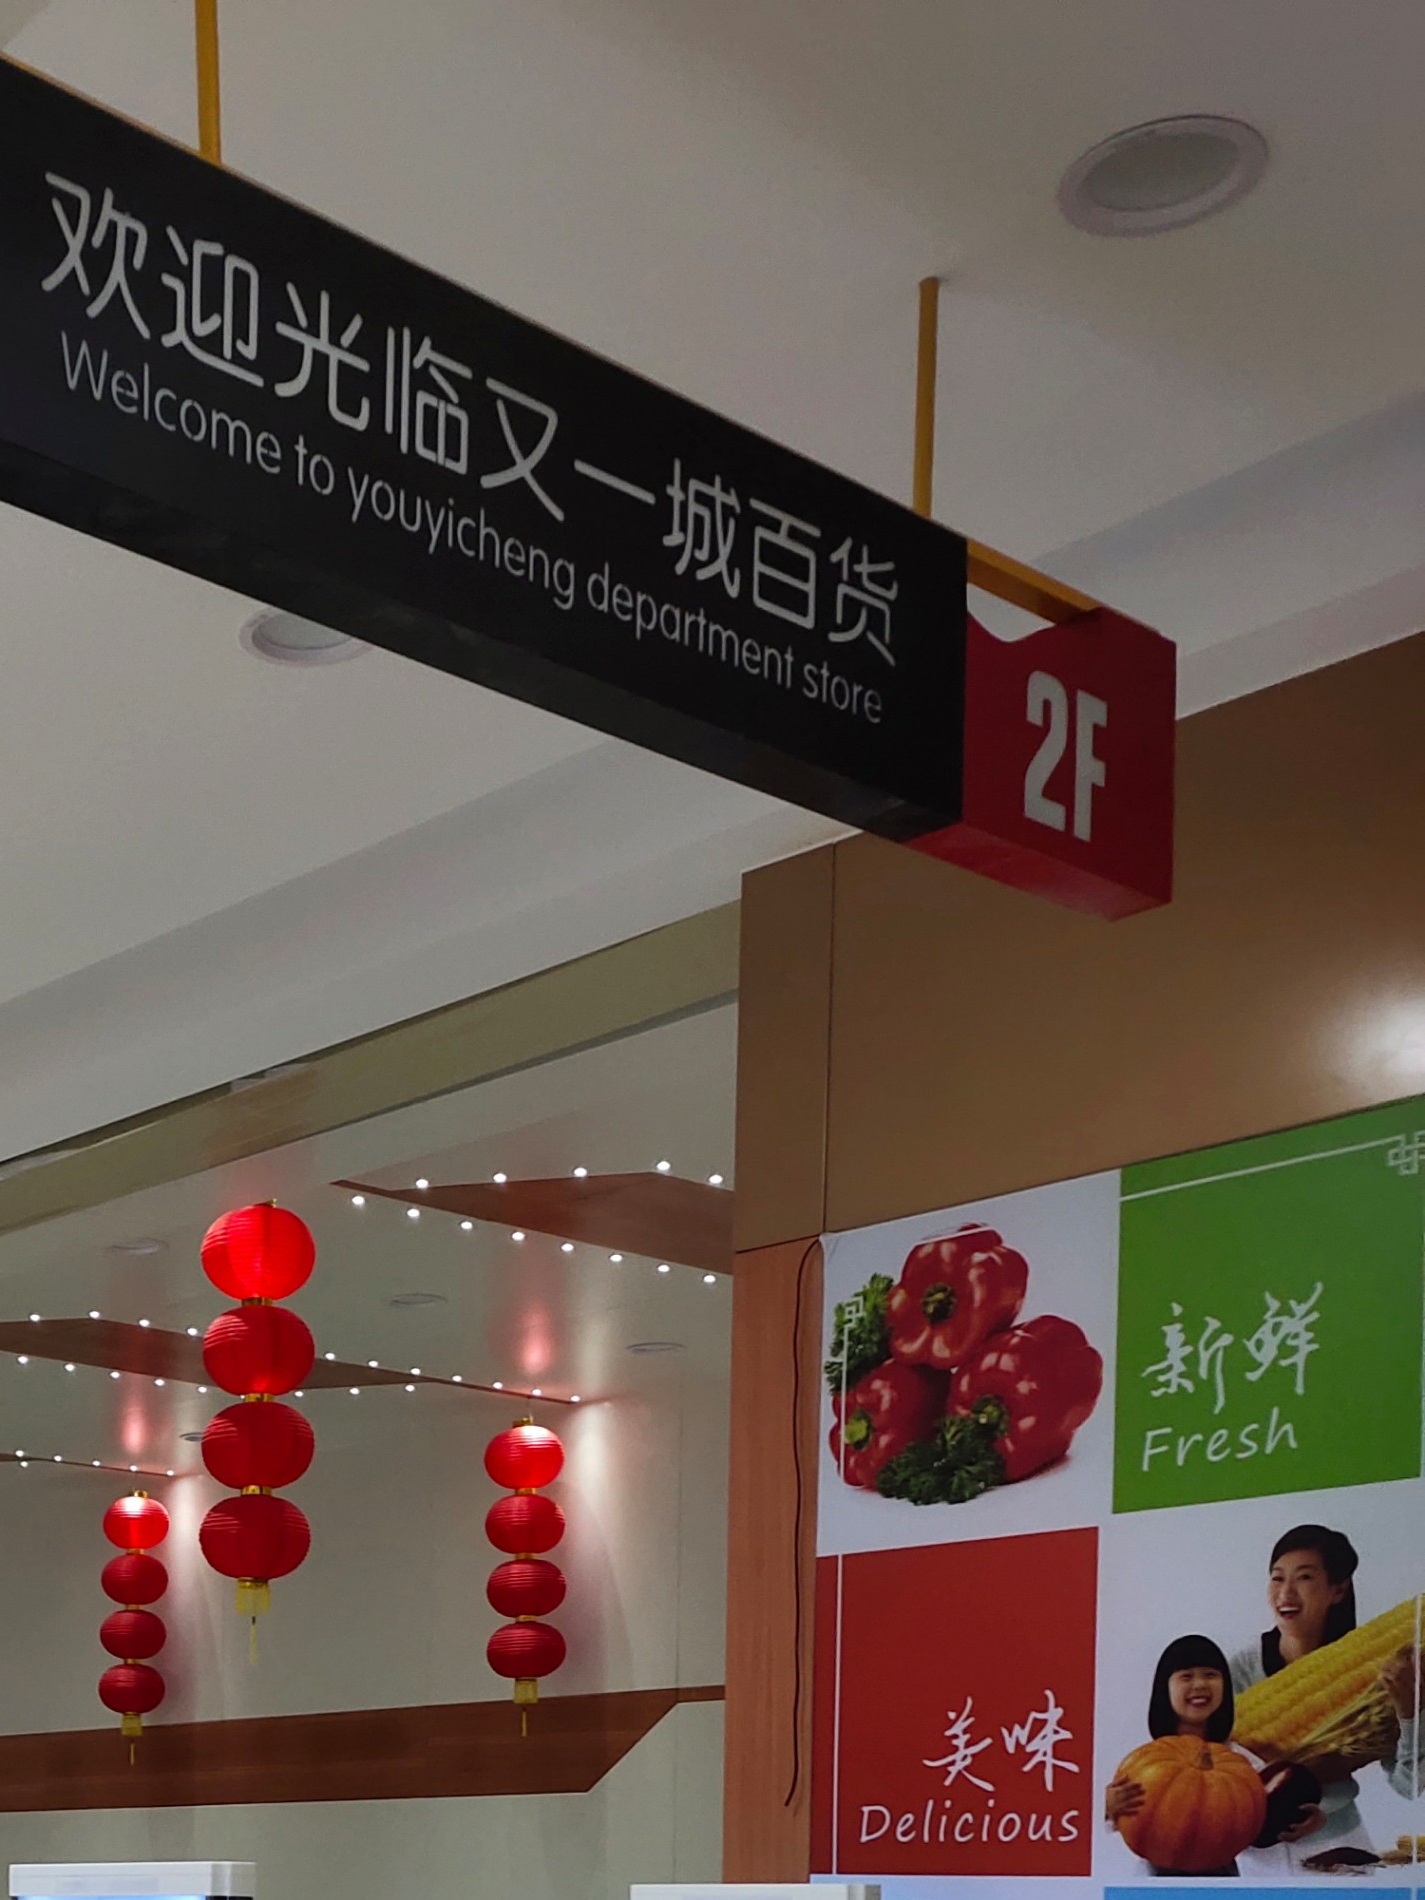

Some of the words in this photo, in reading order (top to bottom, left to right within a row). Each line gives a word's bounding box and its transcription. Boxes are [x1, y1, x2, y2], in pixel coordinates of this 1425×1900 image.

[41, 170, 902, 668] 欢迎光临又一城百货
[60, 331, 283, 479] Welcome
[293, 433, 337, 496] to
[348, 457, 577, 610] youyicheng
[587, 562, 797, 695] department
[802, 655, 885, 724] store
[1024, 670, 1108, 843] 2F
[1141, 1281, 1326, 1414] 新鲜
[1142, 1406, 1298, 1472] Fresh
[922, 1689, 1080, 1791] 美味
[859, 1802, 1080, 1845] Delicious
